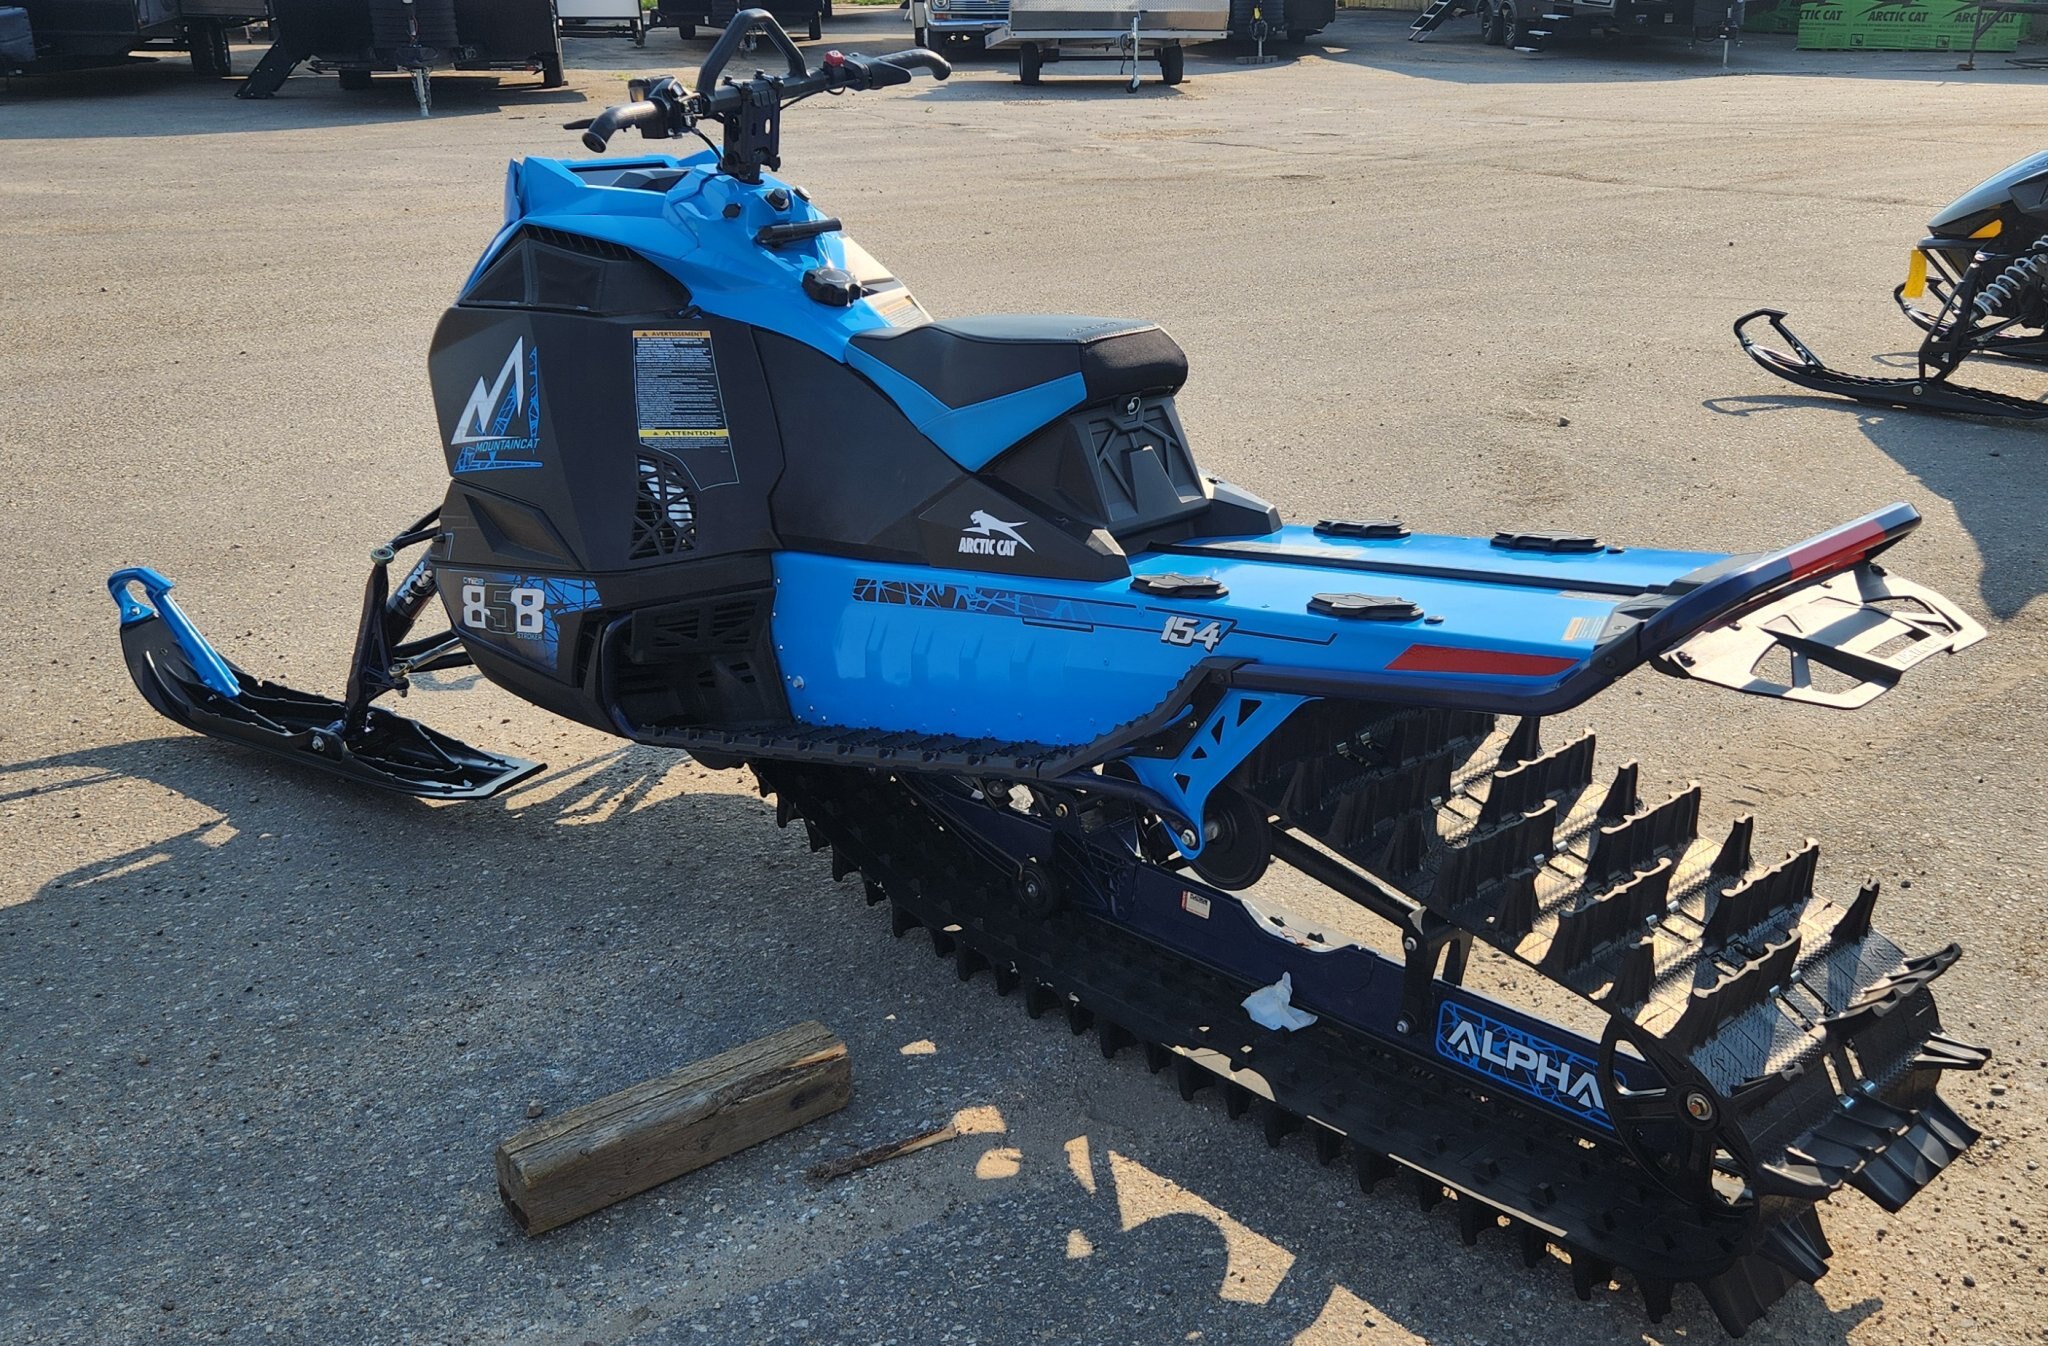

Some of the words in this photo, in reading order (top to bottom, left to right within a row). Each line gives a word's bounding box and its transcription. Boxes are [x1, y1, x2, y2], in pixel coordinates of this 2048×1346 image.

[1822, 10, 1844, 21] CAT
[1867, 11, 1906, 22] ARCTIC
[1908, 11, 1929, 23] CAT
[1996, 12, 2017, 23] AT
[475, 438, 541, 452] MOUNTAINCAT
[958, 536, 996, 555] ARCTIC
[996, 539, 1018, 557] CAT
[462, 583, 545, 635] 858
[516, 632, 543, 640] STROKER
[1160, 615, 1221, 654] 154
[1447, 1020, 1605, 1111] ALPHA
